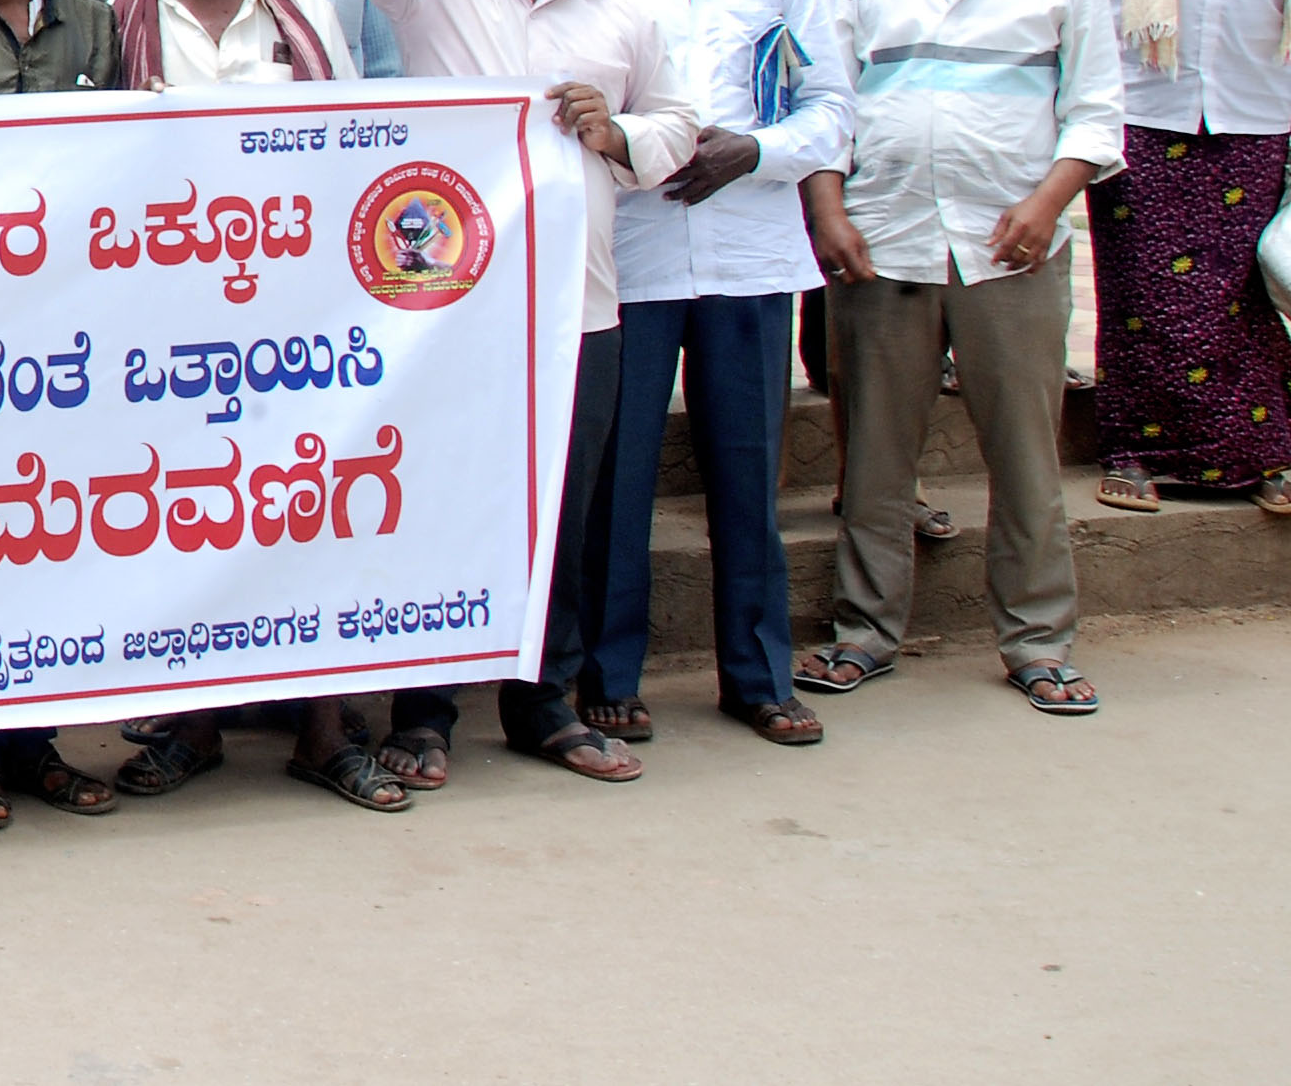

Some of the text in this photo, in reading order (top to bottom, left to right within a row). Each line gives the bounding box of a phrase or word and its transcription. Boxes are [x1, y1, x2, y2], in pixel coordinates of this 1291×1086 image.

[240, 118, 409, 155] ಕಾರ್ಮಿಕ ಬೆಳಗಲಿ
[88, 181, 313, 305] ಒಕ್ಕೂಟ
[124, 325, 385, 425] ಒತ್ತಾಯಿಸಿ
[123, 607, 322, 671] ಜಿಲ್ಲಾಧಿಕಾರಿಗಳ
[338, 588, 492, 644] ಕಛೇರಿವರೆಗೆ
